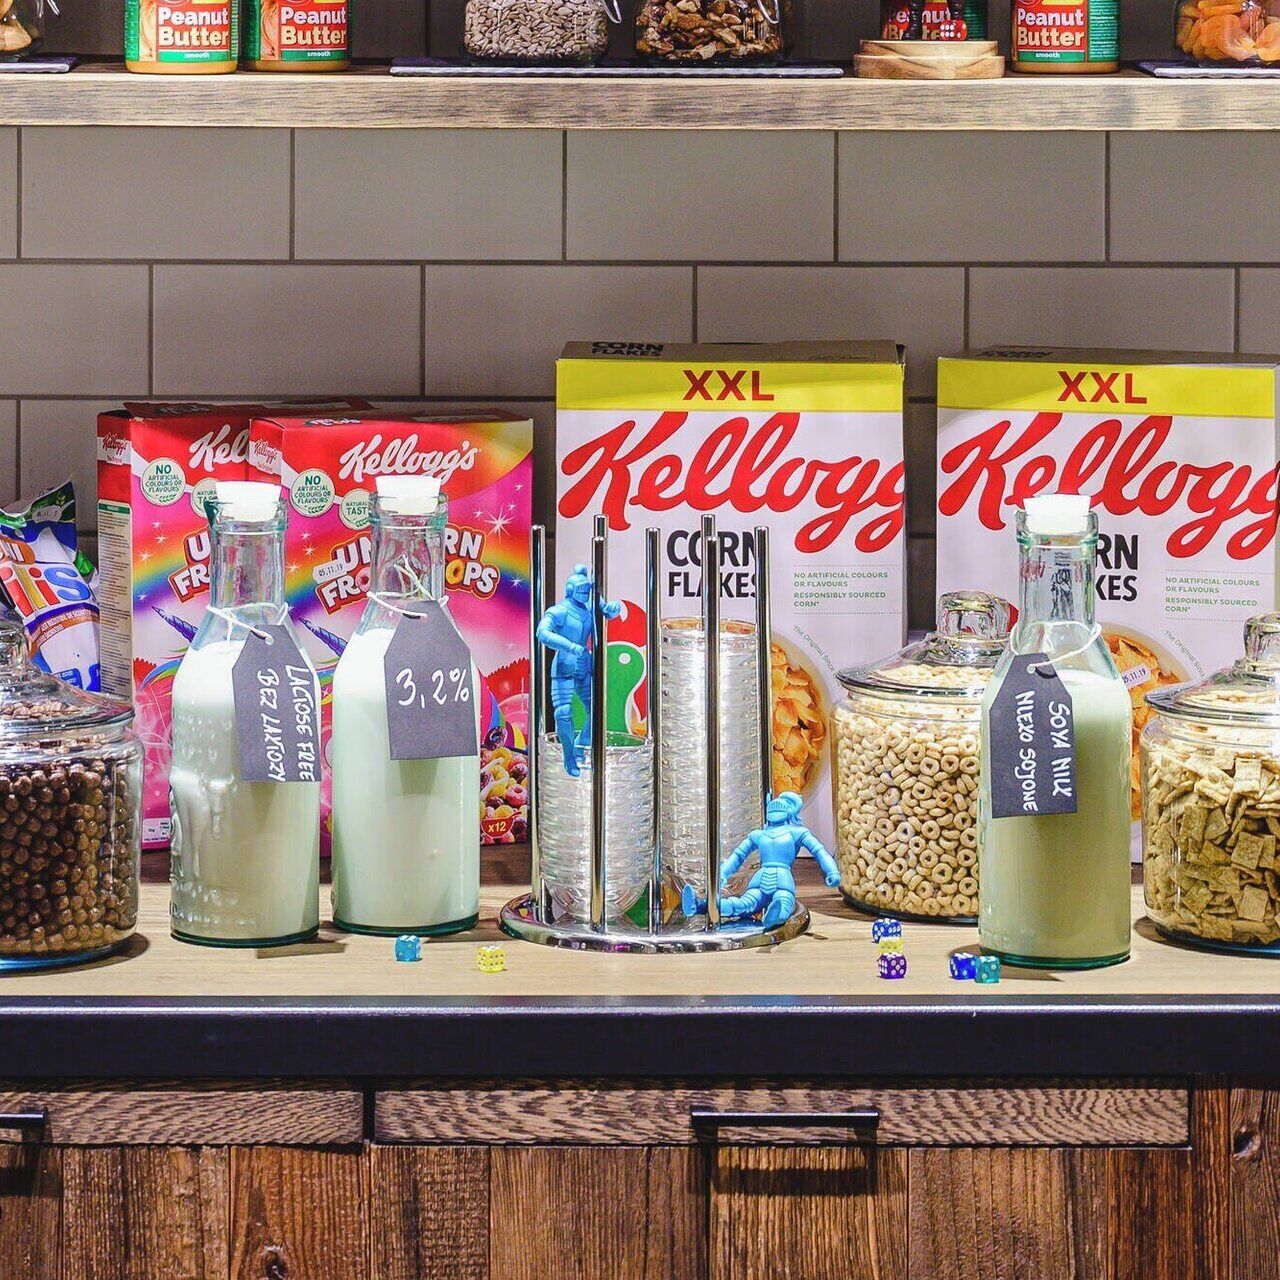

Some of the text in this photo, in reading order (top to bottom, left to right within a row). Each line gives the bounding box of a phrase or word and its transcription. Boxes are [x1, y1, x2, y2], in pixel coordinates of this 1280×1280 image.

[158, 7, 228, 26] Peanut
[280, 7, 346, 26] Peanut
[1017, 9, 1084, 26] Peanut
[158, 26, 229, 46] Butter
[281, 26, 347, 45] Butter
[1018, 27, 1084, 47] Butter
[682, 370, 774, 401] XXL
[1057, 371, 1147, 404] XXL
[338, 433, 477, 484] Kellogg's
[155, 465, 172, 475] NO
[304, 475, 322, 486] NO
[559, 410, 904, 553] Kellogg
[346, 506, 367, 515] TAST
[1096, 533, 1139, 570] RN
[1179, 577, 1221, 585] ARTIFICIAL
[1165, 597, 1218, 605] RESPONSIBLY
[257, 668, 280, 709] BEZ
[395, 668, 470, 709] 3,2%
[284, 664, 316, 781] LACTOSE FREE
[1048, 700, 1071, 748] SOYA
[487, 821, 507, 832] x12
